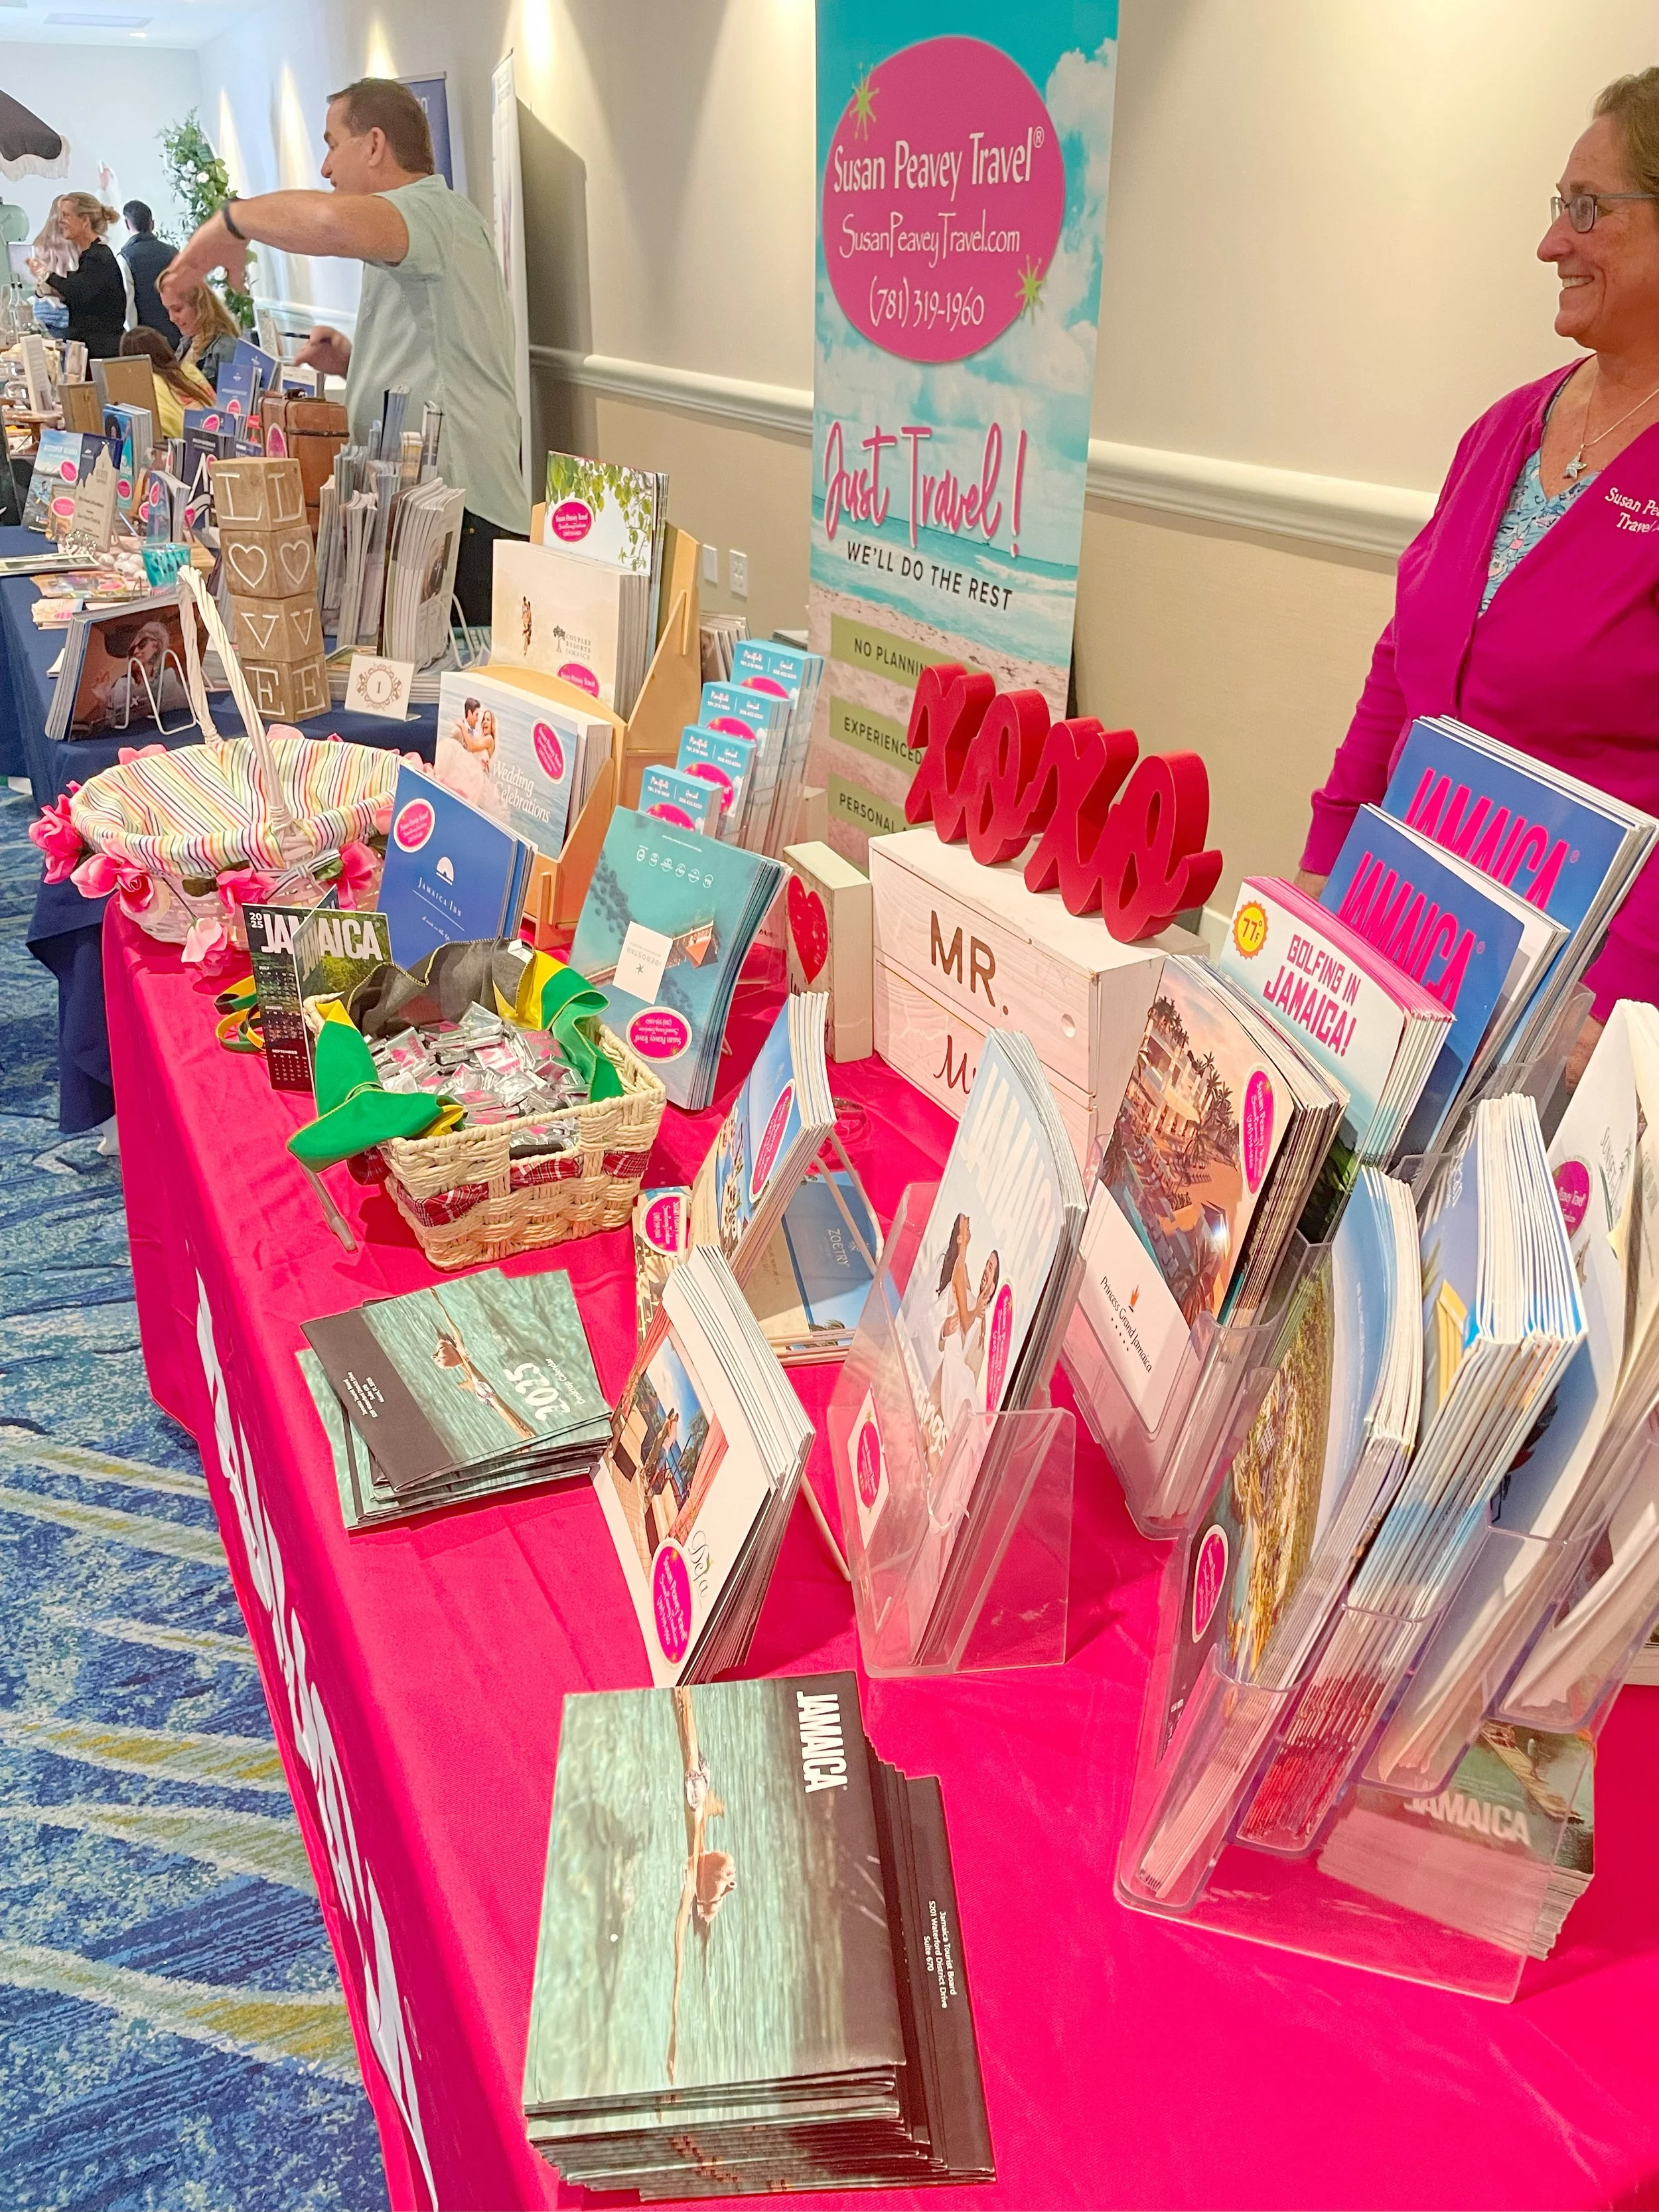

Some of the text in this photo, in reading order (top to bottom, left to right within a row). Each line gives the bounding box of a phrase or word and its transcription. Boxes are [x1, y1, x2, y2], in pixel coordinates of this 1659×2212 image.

[833, 145, 885, 192] Susan
[894, 139, 962, 202] Peavey
[839, 209, 1020, 267] SusanPeaveyTravel.com
[869, 275, 984, 331] (781) 319-1960
[824, 420, 897, 540] Just
[1605, 487, 1642, 512] Susan
[847, 540, 1013, 611] WE'LL DO THE REST
[854, 638, 872, 657] NO
[844, 716, 922, 765] EXPERIENCED
[492, 760, 534, 797] Wedding
[494, 781, 550, 824] Celebrations
[839, 792, 897, 834] PERSONAL
[249, 912, 263, 921] 20
[418, 877, 447, 905] Jamaica
[251, 921, 264, 929] 25
[626, 947, 662, 966] IBEROSTAR
[930, 909, 1009, 1016] MR.
[1286, 933, 1361, 1007] GOLFING IN
[1263, 967, 1358, 1057] JAMAICA!
[1257, 1081, 1265, 1111] Susan
[1099, 1276, 1153, 1374] Princess Grand Jamaica
[503, 1362, 571, 1422] 2025
[545, 1357, 587, 1406] Desktop Calendar
[662, 1555, 675, 1584] Susan
[669, 1580, 682, 1614] Peavey
[796, 1690, 848, 1793] JAMAICA
[923, 1936, 932, 1955] Suite
[928, 1901, 948, 2008] 5201 Waterford District Drive
[939, 1911, 957, 1995] Jamaica Tourist Board
